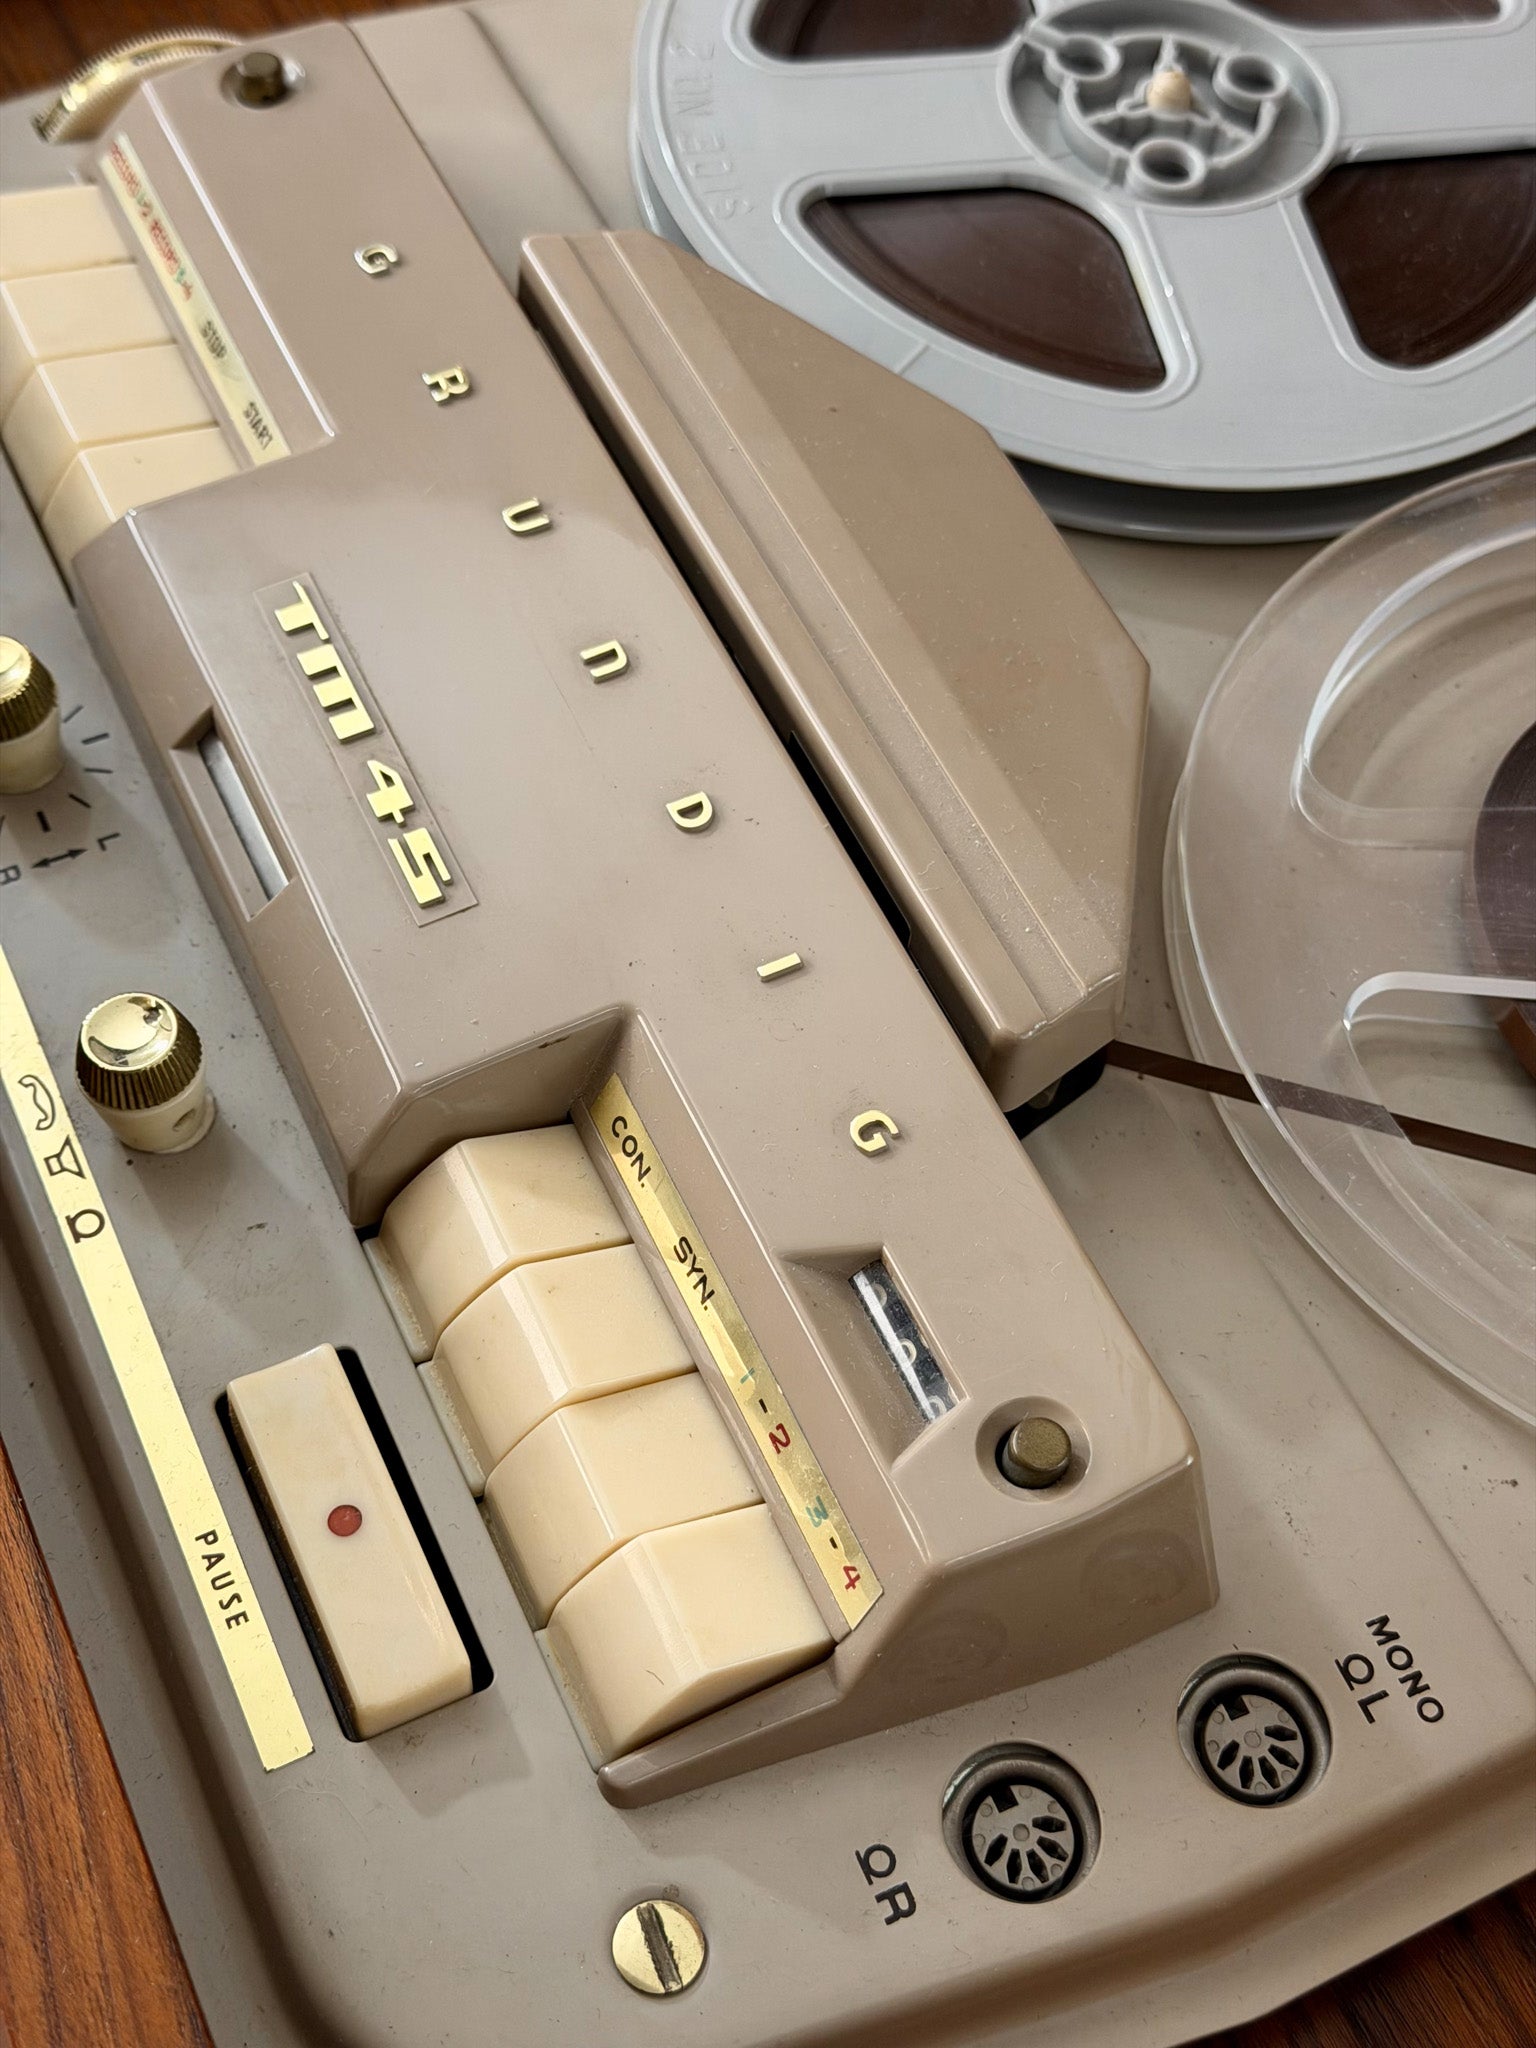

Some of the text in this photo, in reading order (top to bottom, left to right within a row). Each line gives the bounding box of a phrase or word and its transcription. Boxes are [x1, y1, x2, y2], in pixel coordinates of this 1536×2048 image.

[242, 401, 273, 451] START
[97, 832, 121, 851] L
[611, 1115, 652, 1188] CON.
[673, 1236, 716, 1311] SYN.
[194, 1528, 250, 1630] PAUSE
[1365, 1614, 1444, 1723] MONO
[1357, 1689, 1390, 1724] L
[874, 1881, 917, 1926] R
